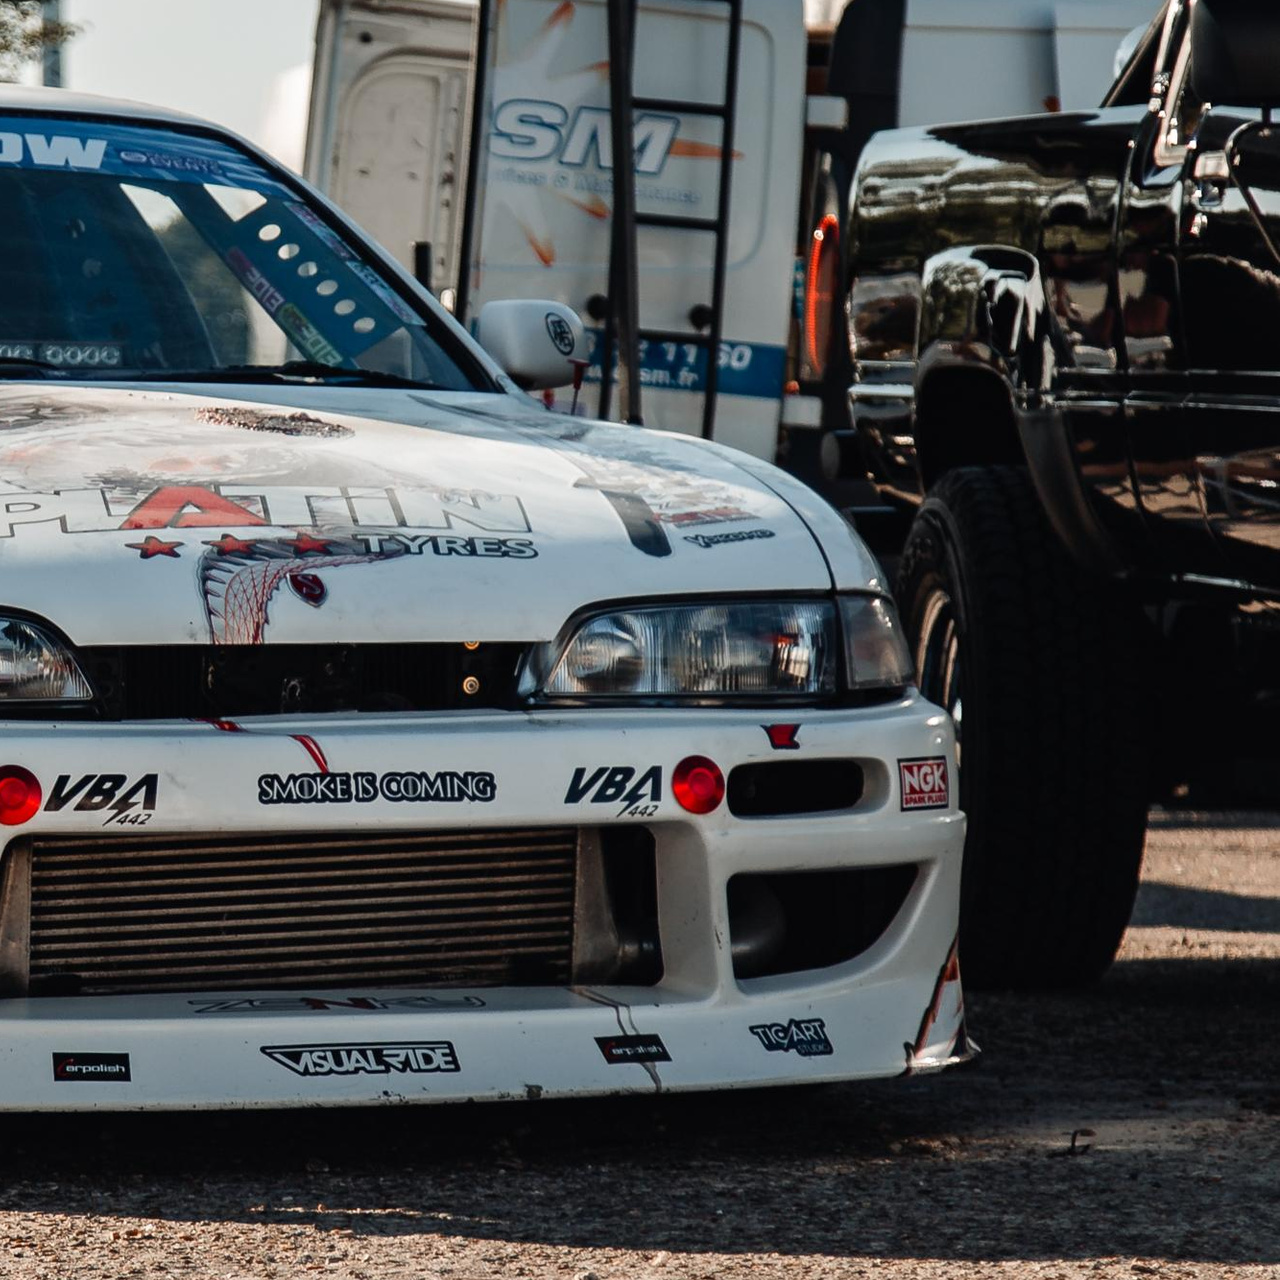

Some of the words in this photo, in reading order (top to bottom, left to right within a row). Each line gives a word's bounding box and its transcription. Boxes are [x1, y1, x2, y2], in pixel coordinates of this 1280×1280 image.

[355, 532, 540, 560] TYRES
[260, 776, 349, 801] SMOKE
[356, 775, 374, 799] IS
[382, 774, 492, 799] COMING
[564, 765, 662, 818] VBA
[903, 764, 947, 794] NGK
[43, 773, 159, 827] VBA
[628, 805, 659, 817] 442
[116, 813, 153, 826] 442
